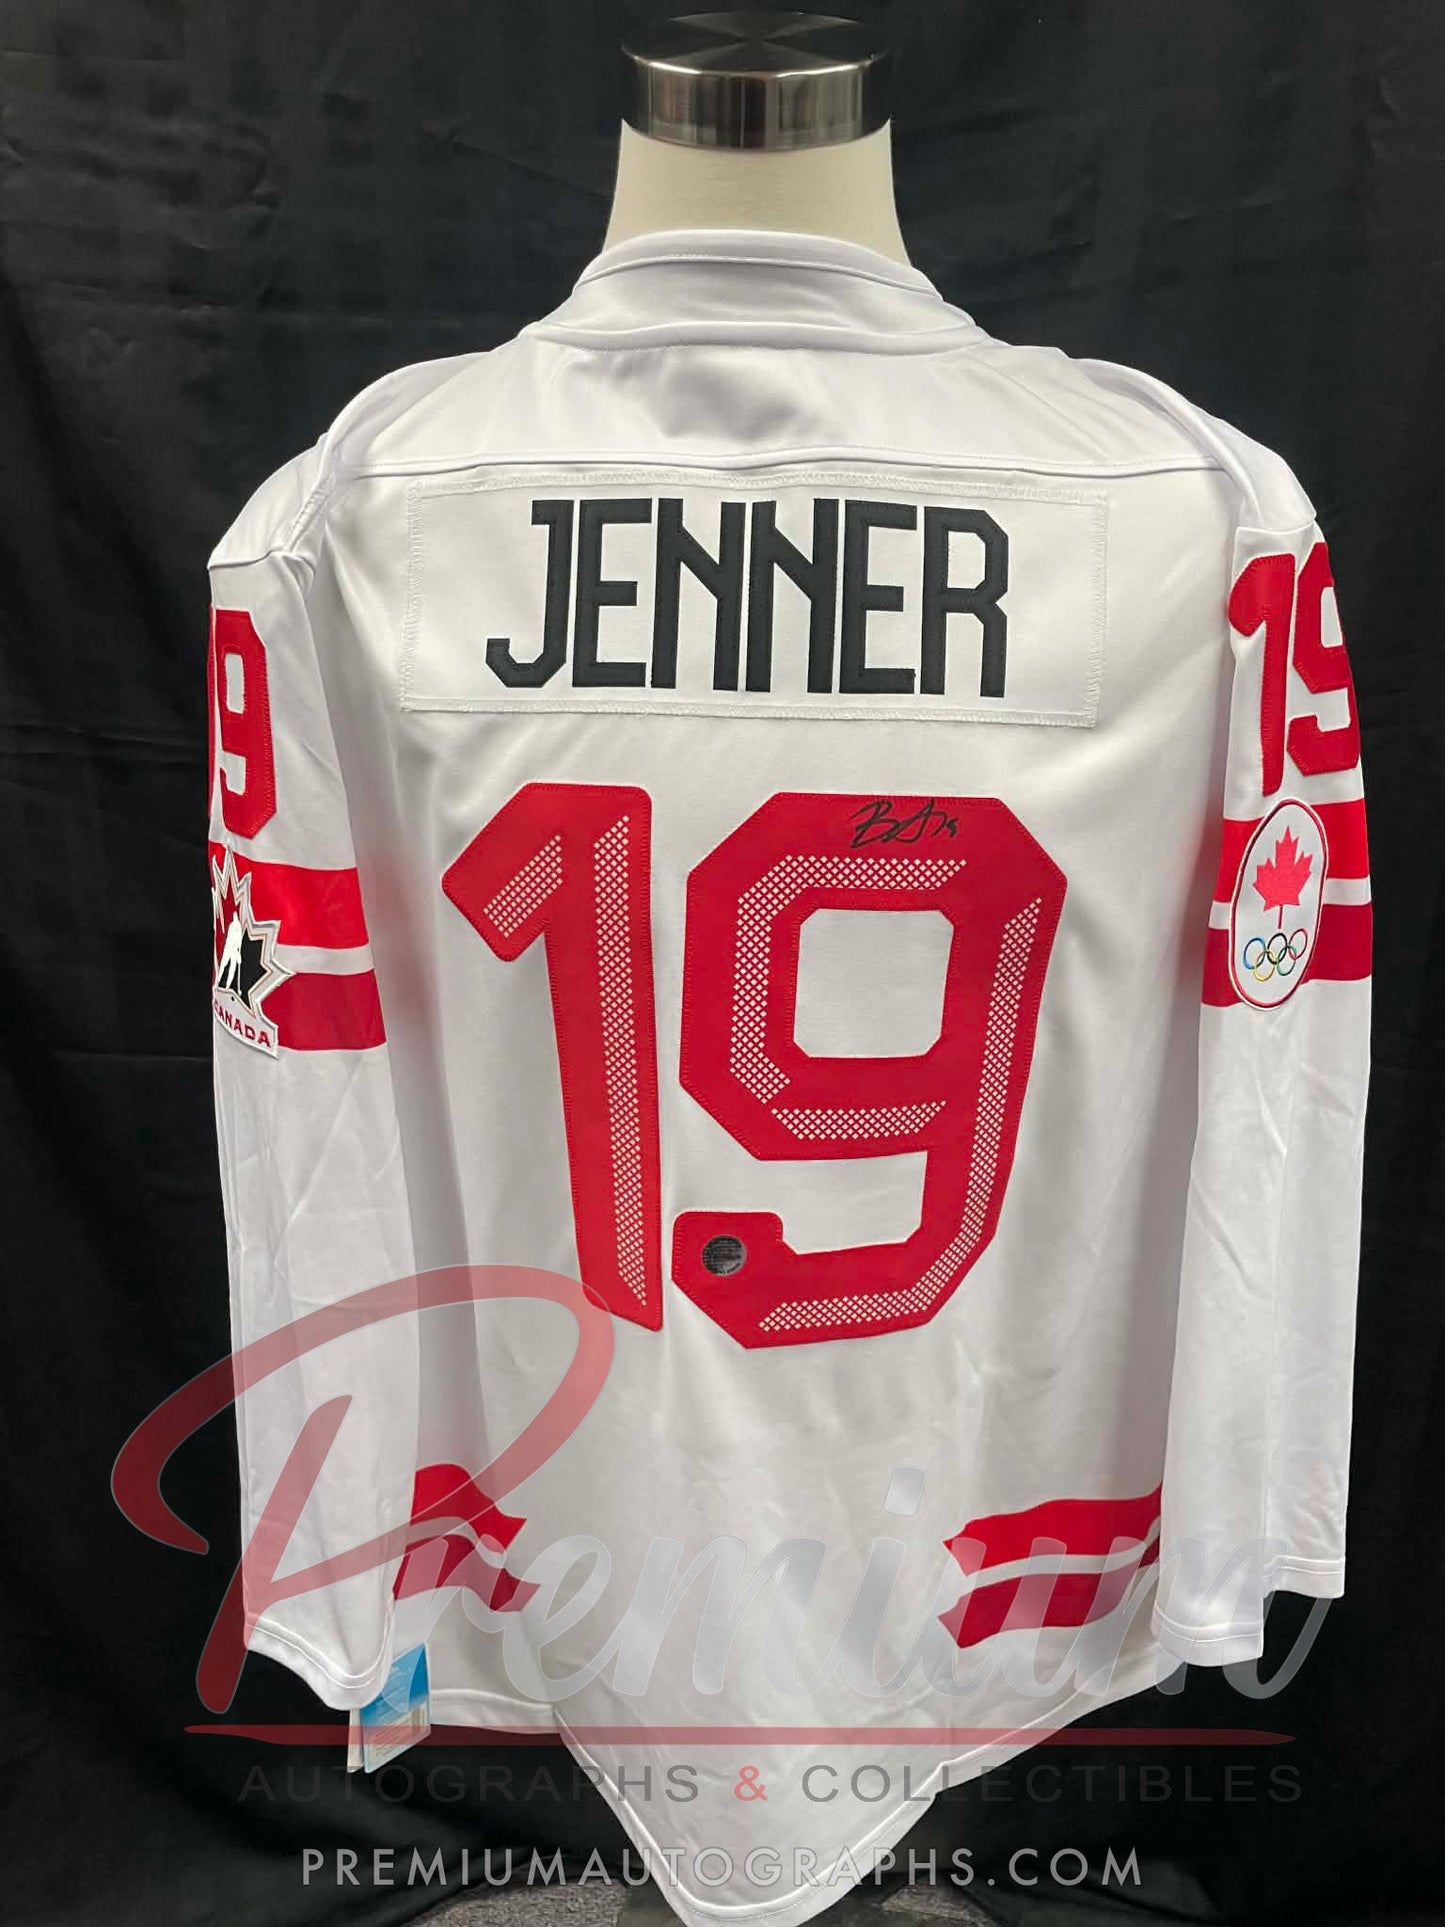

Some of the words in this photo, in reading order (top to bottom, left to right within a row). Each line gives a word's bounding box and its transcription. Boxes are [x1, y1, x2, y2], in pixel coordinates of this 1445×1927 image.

[486, 496, 1010, 698] JENNER
[1228, 542, 1361, 797] 19
[213, 998, 272, 1049] CANADA
[441, 782, 1068, 1349] 19
